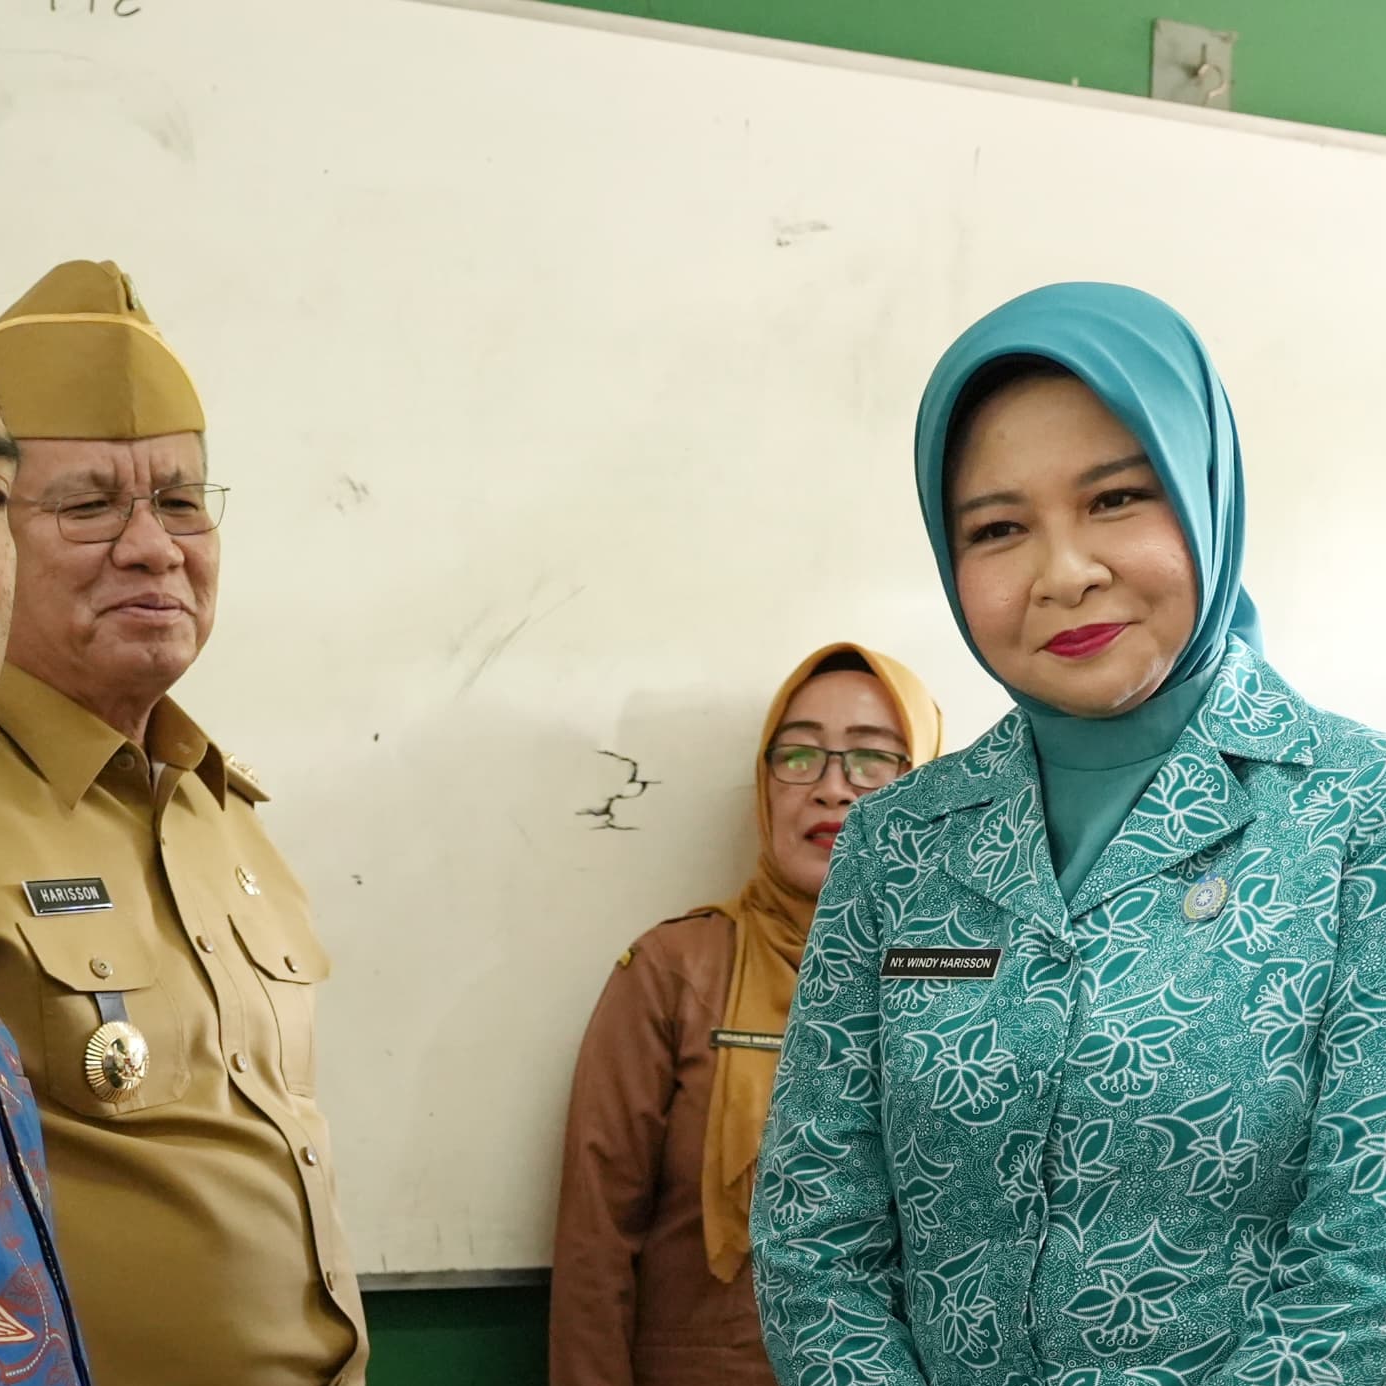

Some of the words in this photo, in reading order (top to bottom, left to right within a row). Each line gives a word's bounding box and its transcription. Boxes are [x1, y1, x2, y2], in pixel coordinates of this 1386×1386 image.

[39, 885, 100, 902] HARISSON
[889, 957, 905, 968] NY.
[906, 957, 939, 968] WINDY
[939, 957, 992, 969] HARISSON
